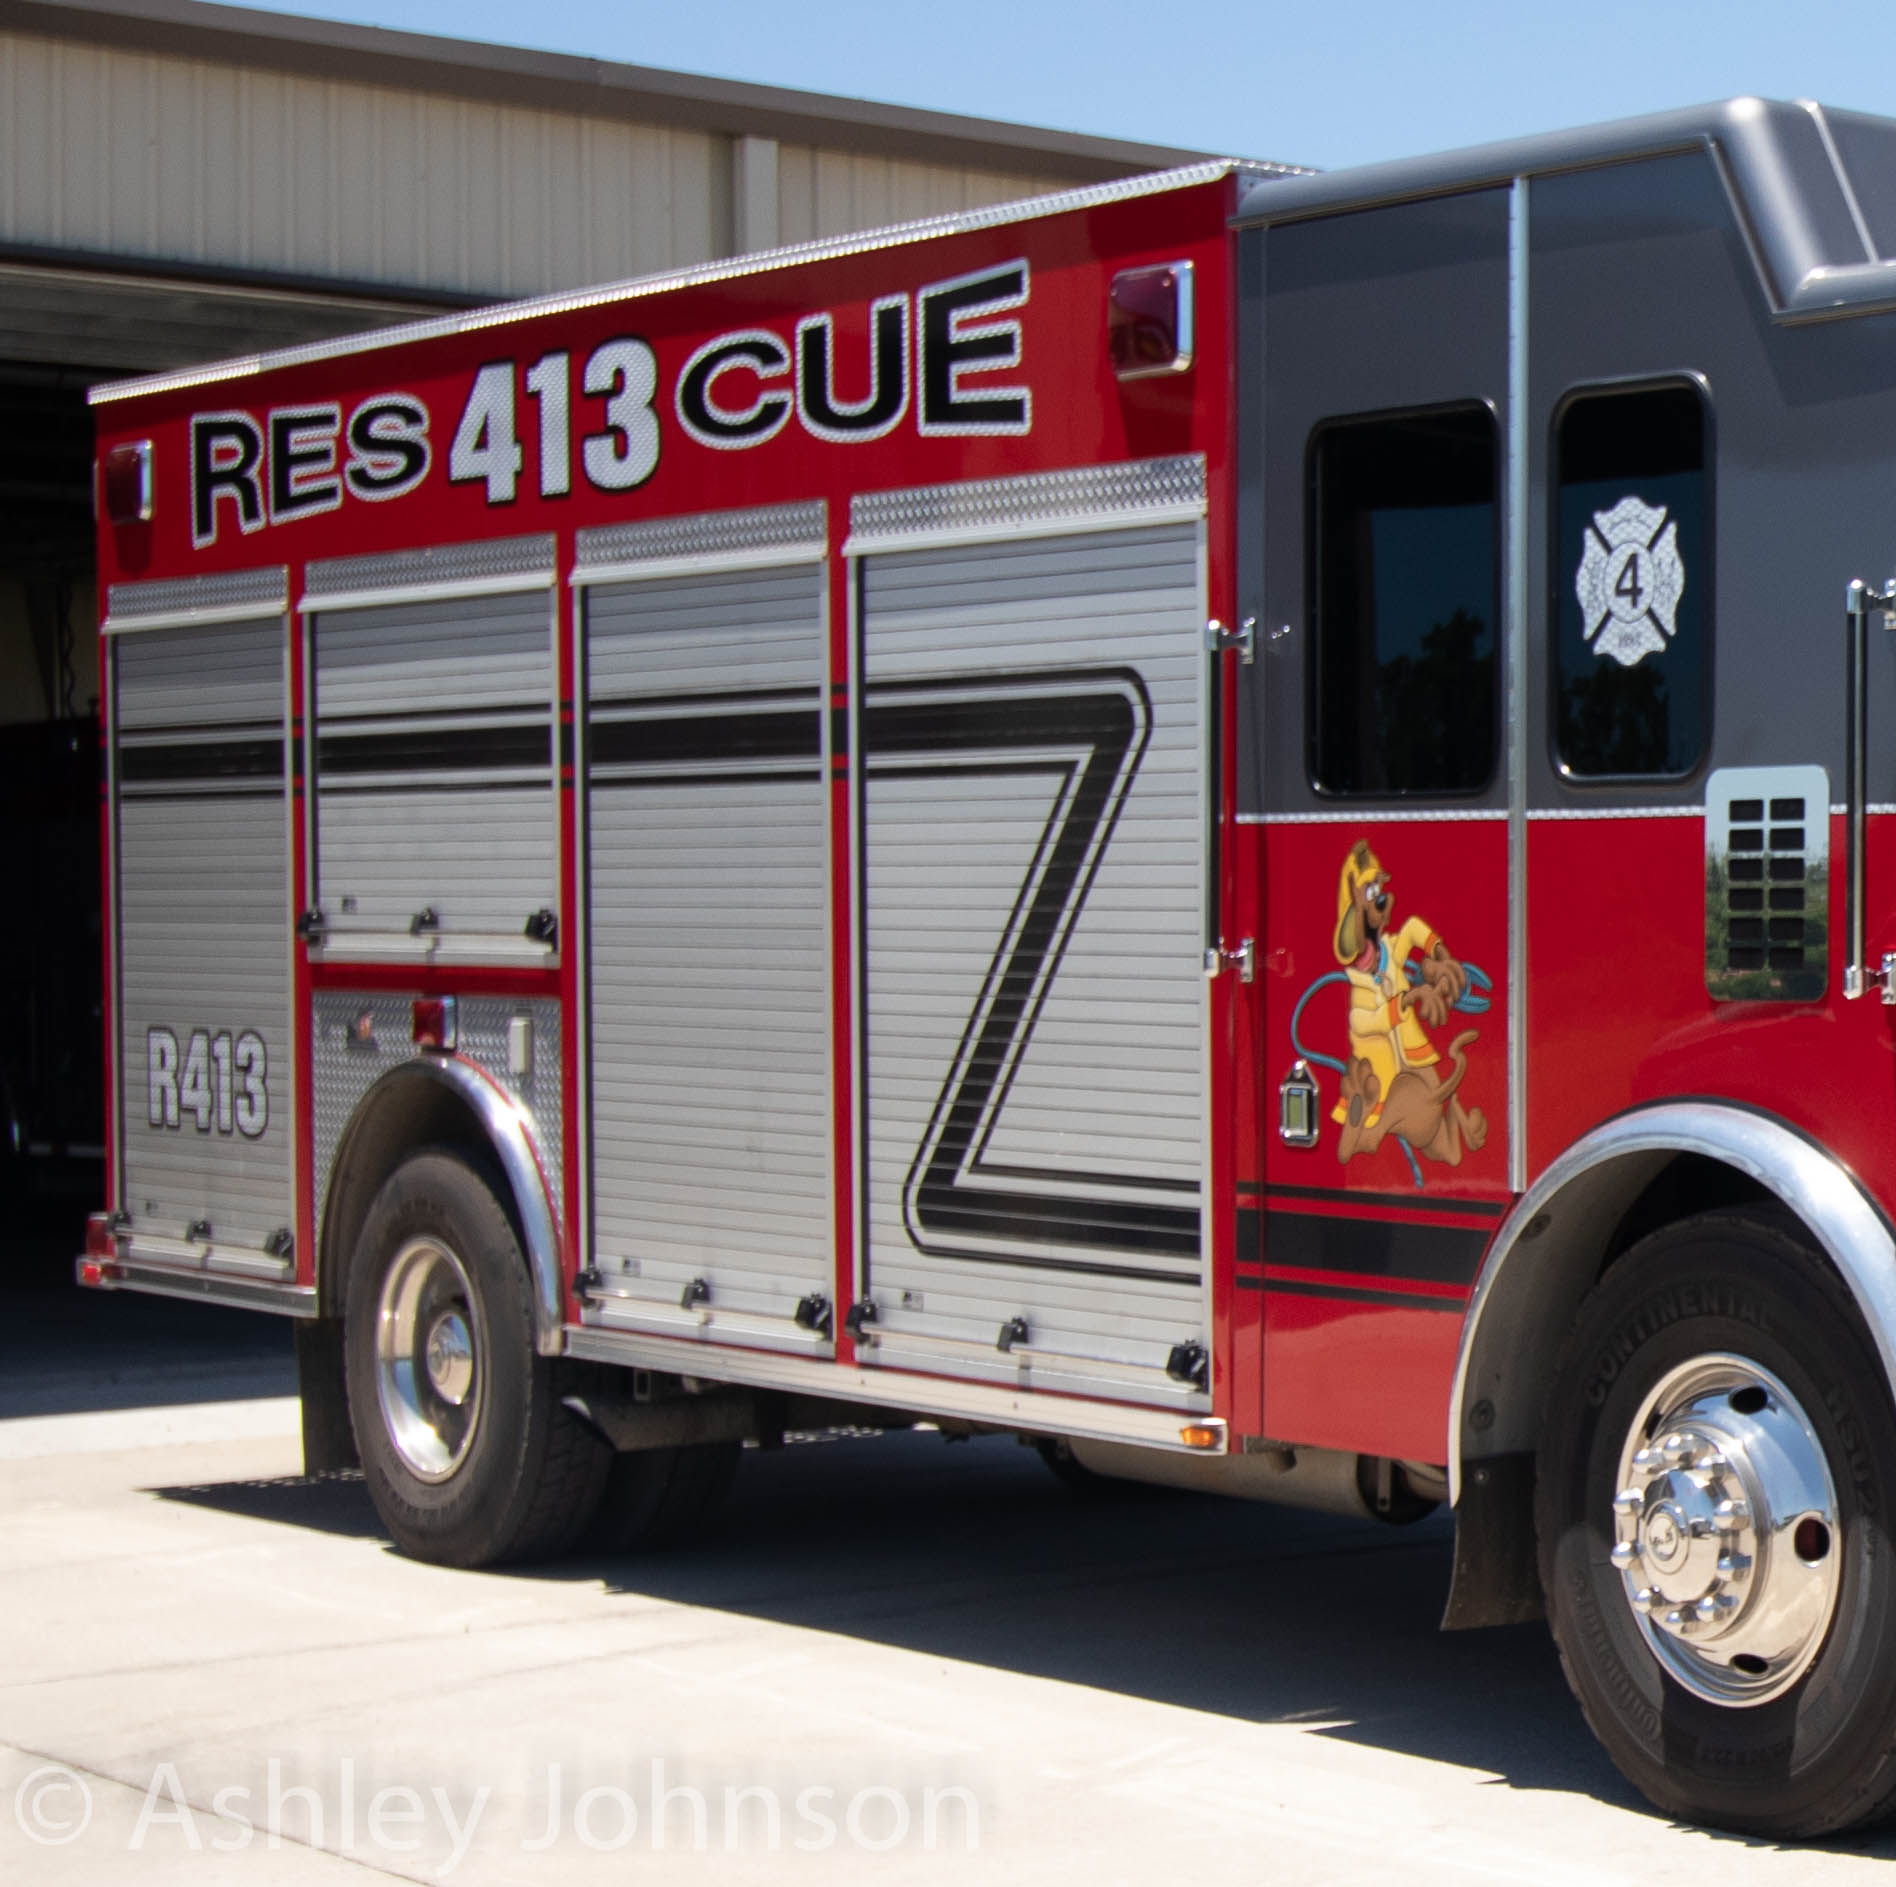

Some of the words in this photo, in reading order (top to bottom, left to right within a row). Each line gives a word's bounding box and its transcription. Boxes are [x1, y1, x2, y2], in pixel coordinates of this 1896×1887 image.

[190, 391, 432, 551] RES
[447, 333, 661, 506] 413
[675, 256, 1033, 451] CUE
[1613, 552, 1644, 609] 4
[147, 1025, 270, 1139] R413
[1587, 1281, 1775, 1407] CONTINENTAL
